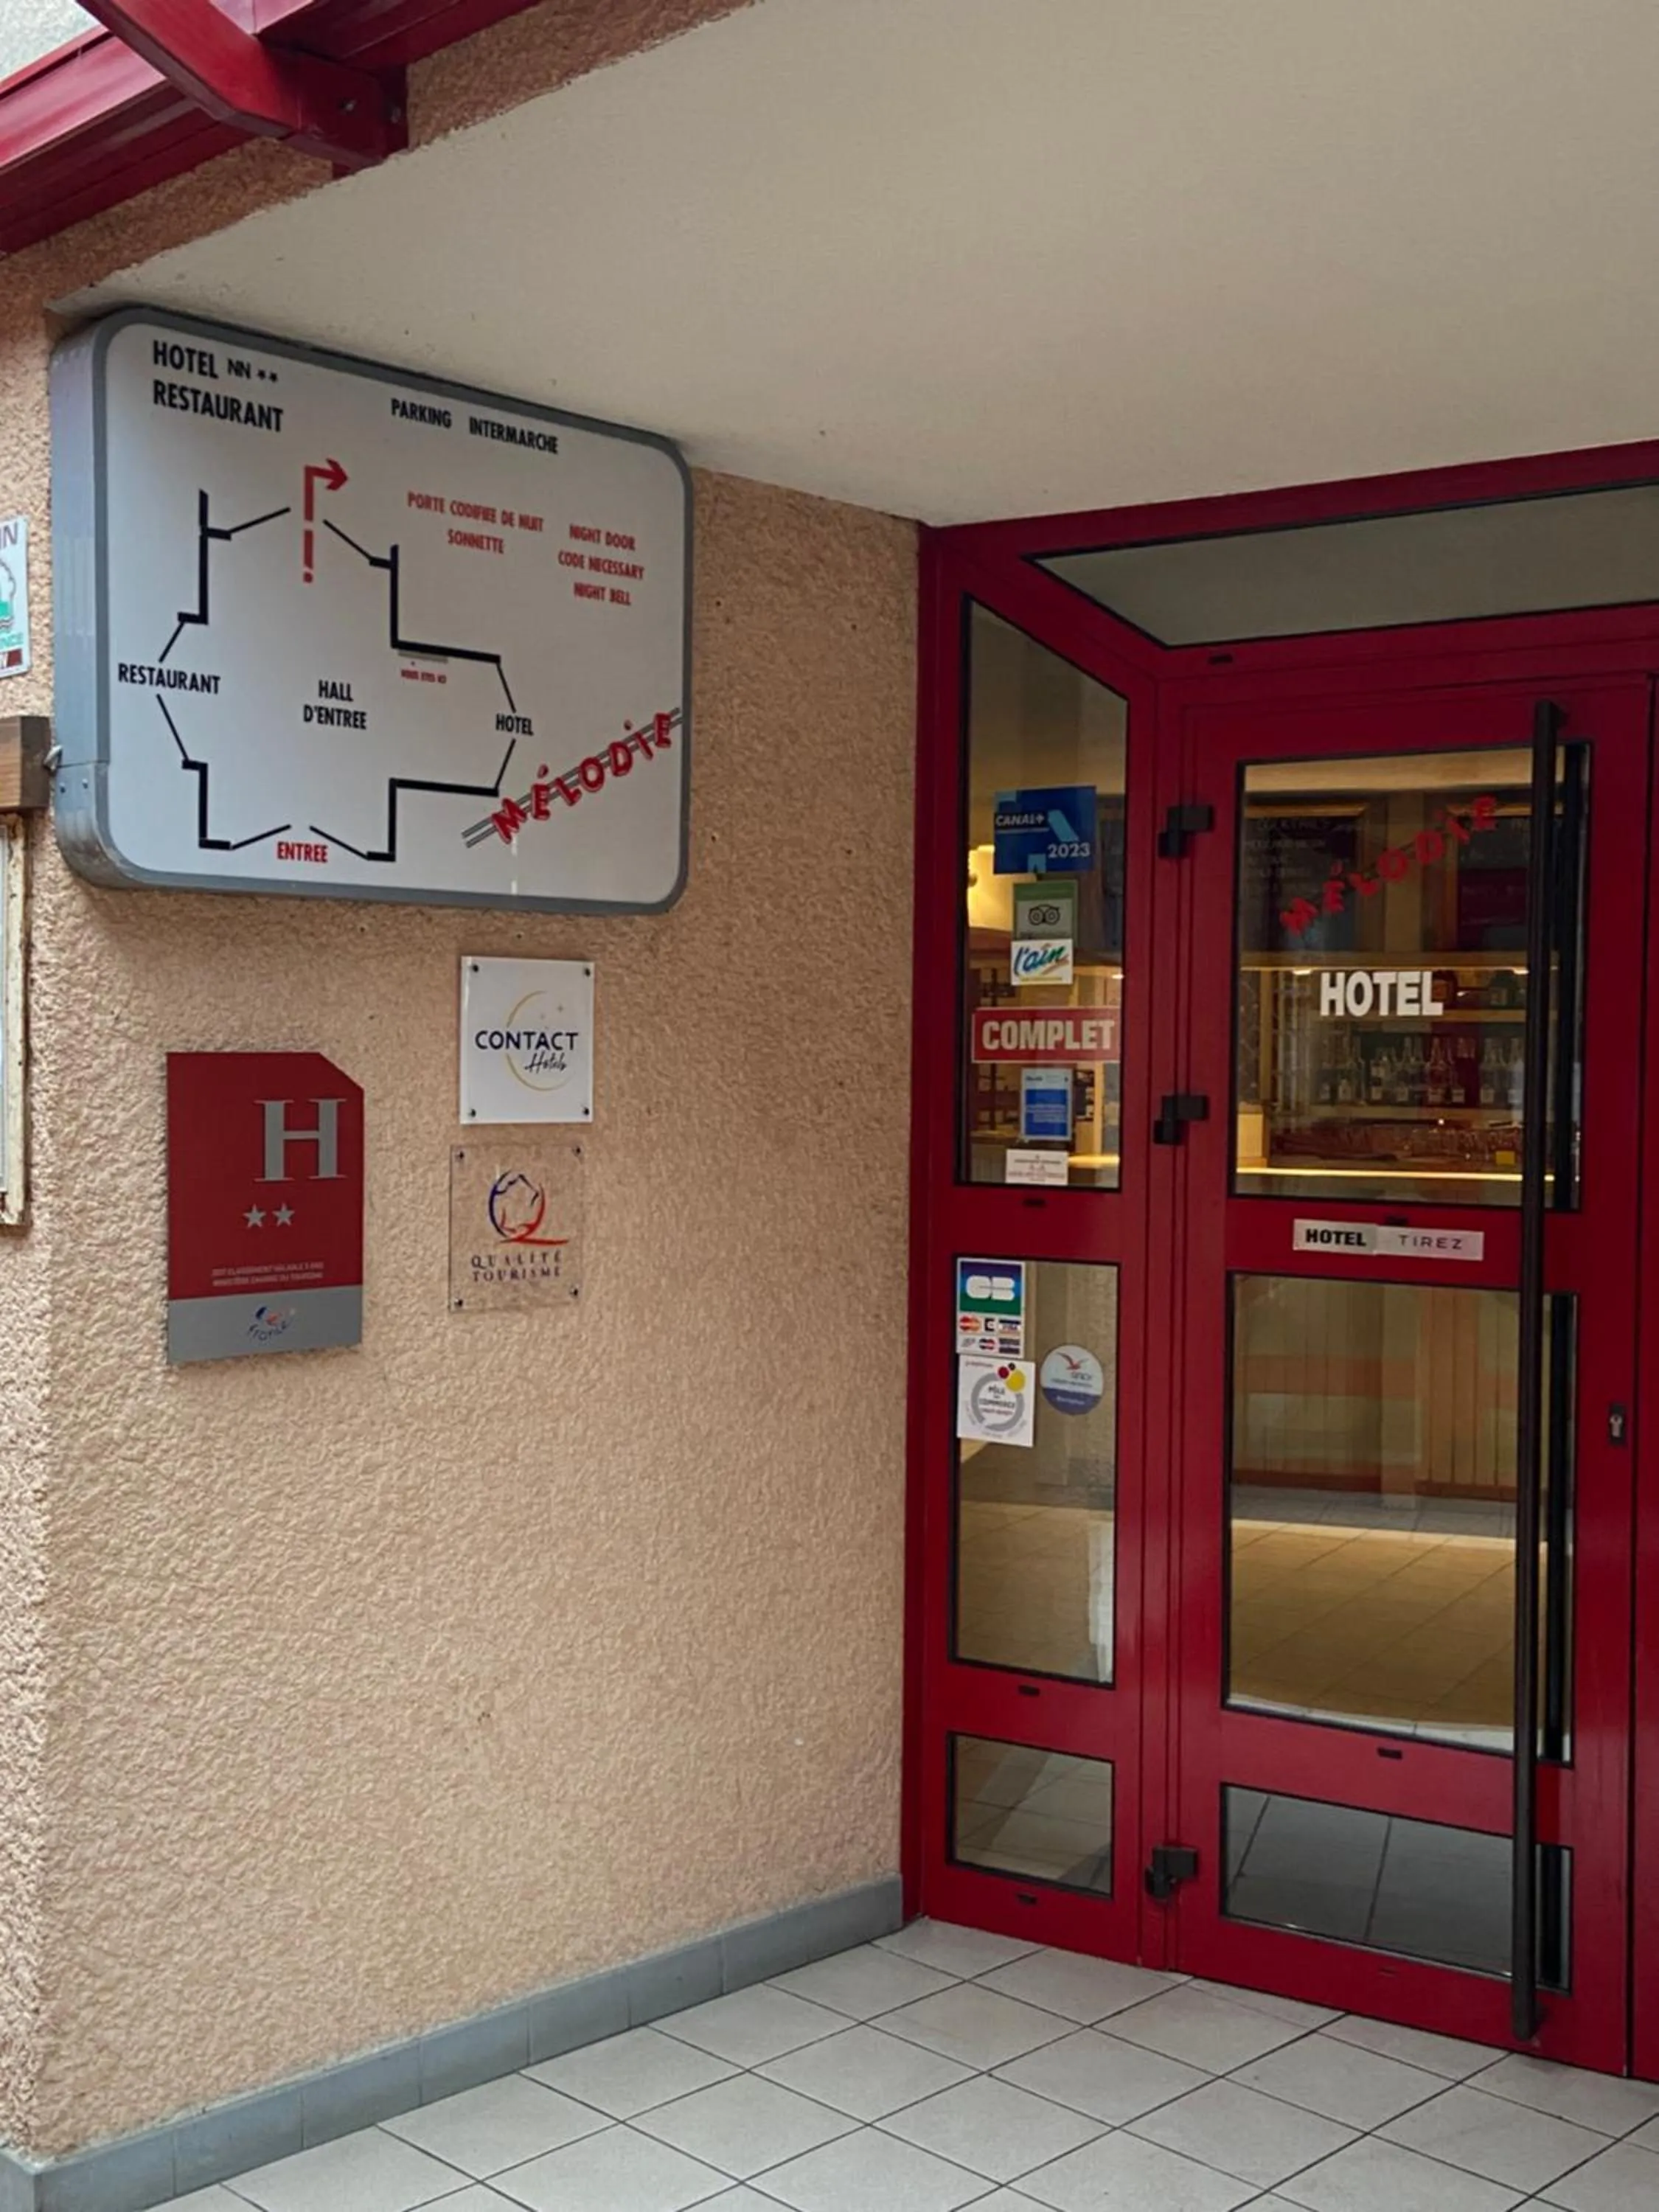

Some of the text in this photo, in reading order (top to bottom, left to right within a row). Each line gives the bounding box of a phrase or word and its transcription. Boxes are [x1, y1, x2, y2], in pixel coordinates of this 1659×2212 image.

[153, 340, 218, 379] HOTEL
[153, 379, 284, 432] RESTAURANT
[391, 398, 559, 454] PARKING INTERMARCHE
[408, 491, 445, 514] PORTE
[501, 509, 515, 527] DE
[519, 514, 545, 532] NUIT
[448, 528, 504, 554] SONNETTE
[569, 524, 636, 551] NIGHT DOOR
[558, 549, 645, 580] CODE NECESSARY
[574, 582, 631, 606] NIGHT BELL
[118, 663, 220, 695] RESTAURANT
[318, 680, 353, 702] HALL
[303, 704, 367, 730] D'ENTREE
[495, 713, 534, 737] HOTEL
[996, 813, 1045, 827] CANAL+
[276, 841, 328, 863] ENTREE
[1048, 843, 1091, 859] 2023
[1321, 971, 1444, 1016] HOTEL
[475, 1030, 579, 1051] CONTACT
[982, 1020, 1115, 1051] COMPLET
[254, 1098, 347, 1183] H
[1305, 1228, 1462, 1251] HOTEL TIREZ
[473, 1266, 560, 1282] TOURISME
